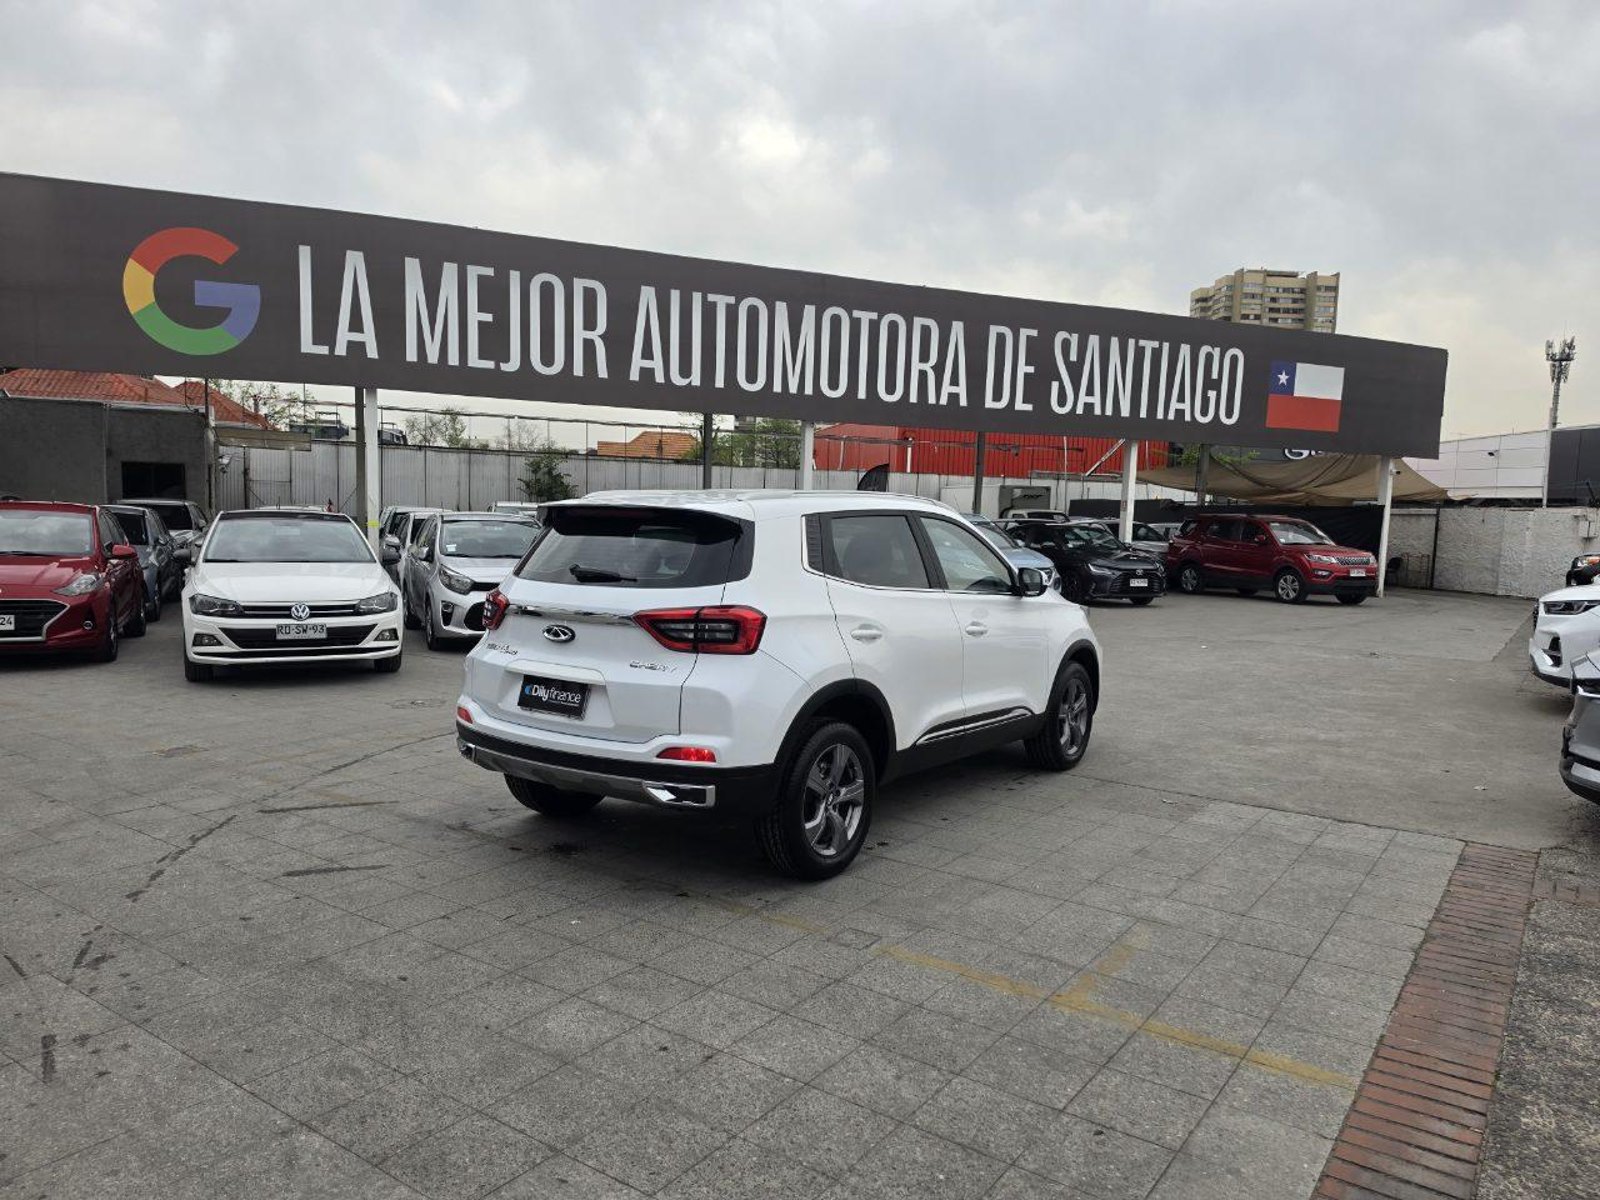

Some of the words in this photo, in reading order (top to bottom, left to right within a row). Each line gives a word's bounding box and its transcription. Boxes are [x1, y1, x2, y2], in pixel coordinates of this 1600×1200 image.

[123, 227, 261, 356] G
[298, 245, 379, 359] LA
[404, 257, 609, 379] MEJOR
[629, 286, 968, 407] AUTOMOTORA
[984, 324, 1039, 411] DE
[1050, 331, 1245, 426] SANTIAGO
